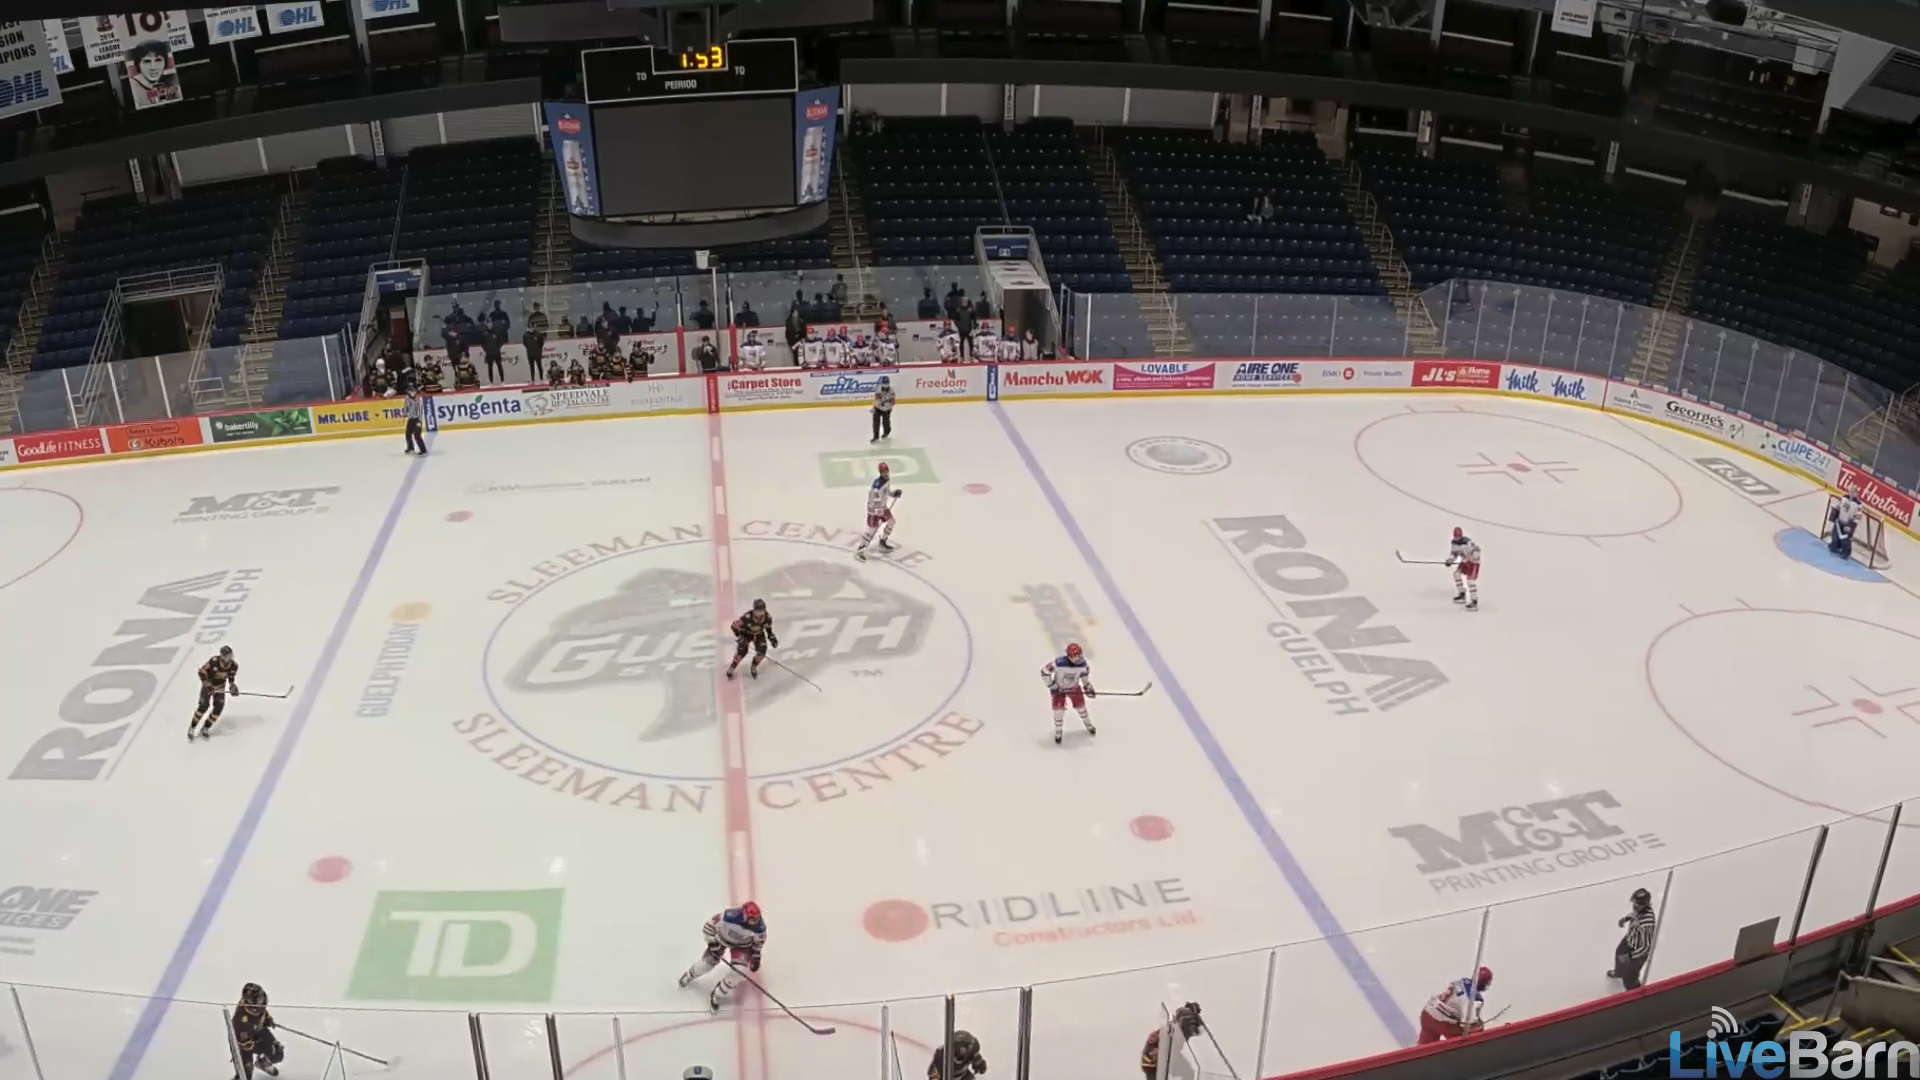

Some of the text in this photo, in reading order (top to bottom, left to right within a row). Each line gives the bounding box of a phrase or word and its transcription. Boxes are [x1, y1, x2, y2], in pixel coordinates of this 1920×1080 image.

[216, 16, 256, 37] OHL
[276, 6, 317, 26] OHL
[731, 377, 802, 390] Carpet Store
[916, 378, 967, 389] Freedom
[1004, 371, 1064, 387] Manchu
[1065, 369, 1104, 385] WOK
[1141, 363, 1189, 374] LOVABLE
[1236, 363, 1300, 375] AIRE ONE
[437, 398, 522, 421] syngenta
[550, 389, 611, 400] SPEEDVALE
[317, 413, 340, 424] MR.
[342, 410, 370, 422] LUBE
[1666, 400, 1726, 428] George's
[17, 440, 57, 457] GoodLife
[58, 437, 101, 452] FITNESS
[178, 486, 342, 516] M&T
[1861, 481, 1910, 523] Hortons
[486, 522, 704, 606] SLEEMAN
[195, 567, 264, 646] GUELPH
[1212, 514, 1451, 714] RONA
[7, 568, 231, 781] RONA
[1266, 620, 1371, 718] GUELPH
[451, 709, 986, 813] SLEEMAN CENTRE
[1387, 789, 1626, 875] M&T
[1428, 837, 1640, 895] PRINTING GROUP
[930, 877, 1192, 930] RIDLINE
[388, 908, 539, 978] TD
[992, 916, 1153, 948] Constructors
